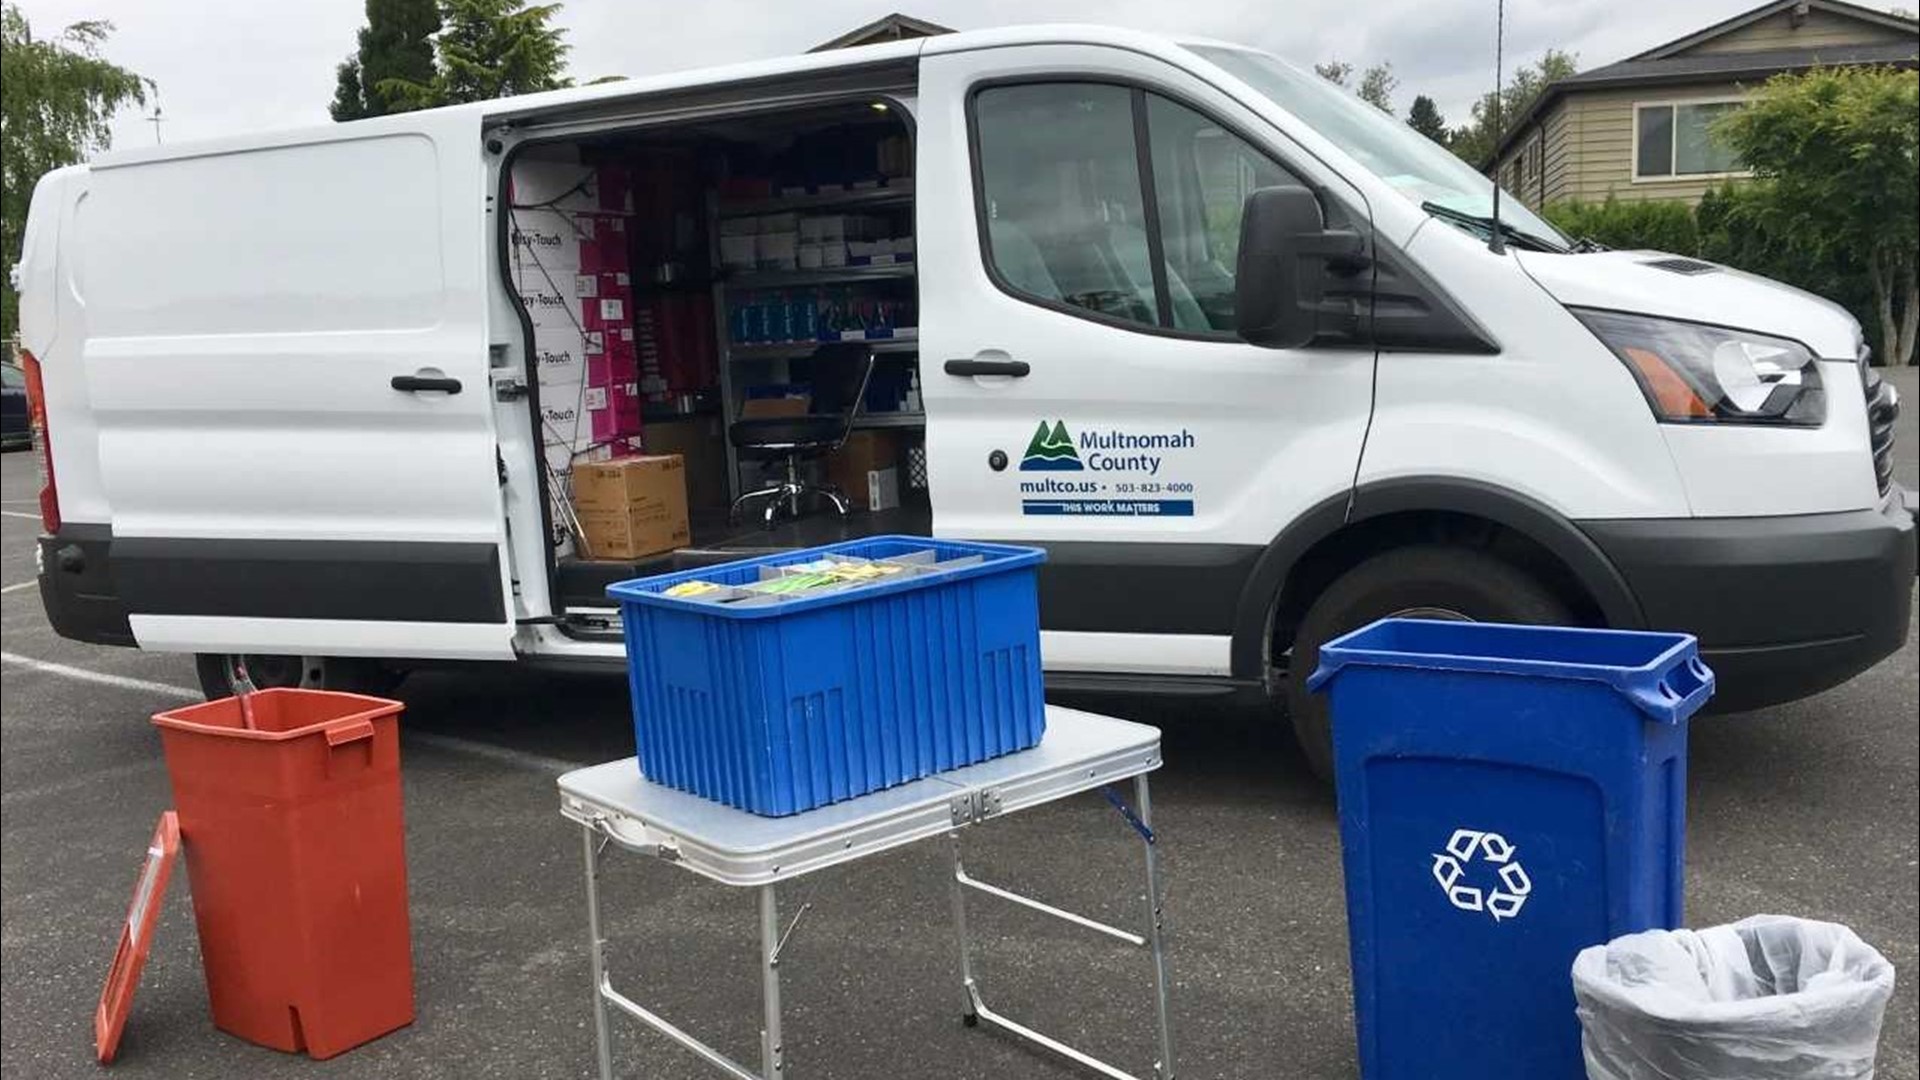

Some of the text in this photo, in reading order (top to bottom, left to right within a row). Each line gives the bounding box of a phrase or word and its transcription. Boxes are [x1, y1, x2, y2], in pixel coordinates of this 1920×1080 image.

[519, 293, 565, 308] sy-Touch
[542, 409, 575, 422] -Touch
[1080, 428, 1195, 449] Multnomah
[1088, 453, 1161, 475] County
[1020, 478, 1193, 493] multco.us 503-823-4000
[1061, 502, 1161, 514] THIS WORK MATTERS
